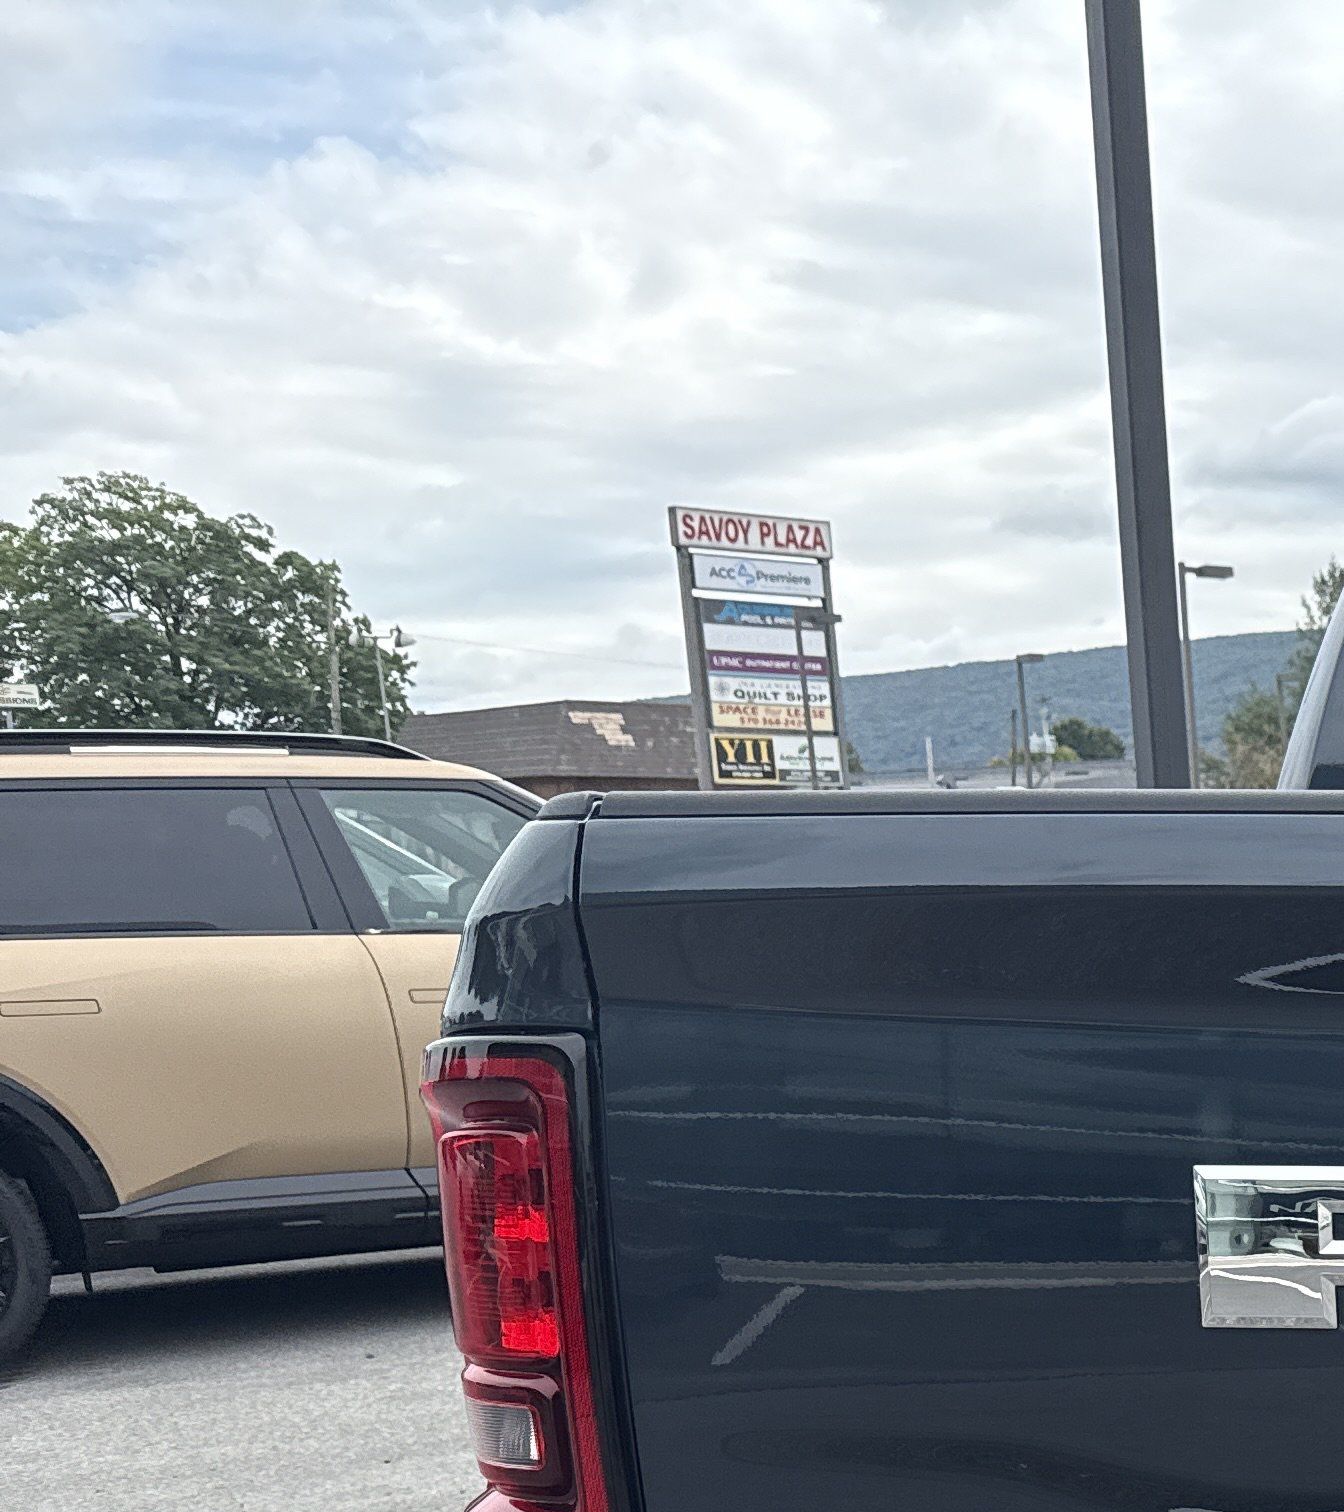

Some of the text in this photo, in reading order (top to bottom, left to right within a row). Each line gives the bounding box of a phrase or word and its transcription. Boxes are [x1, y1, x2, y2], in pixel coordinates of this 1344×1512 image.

[682, 514, 827, 551] SAVOY PLAZA
[709, 567, 736, 580] ACC
[733, 688, 780, 701] QUILT
[719, 705, 758, 716] SPACE
[787, 708, 826, 719] LESE
[719, 738, 771, 763] YII
